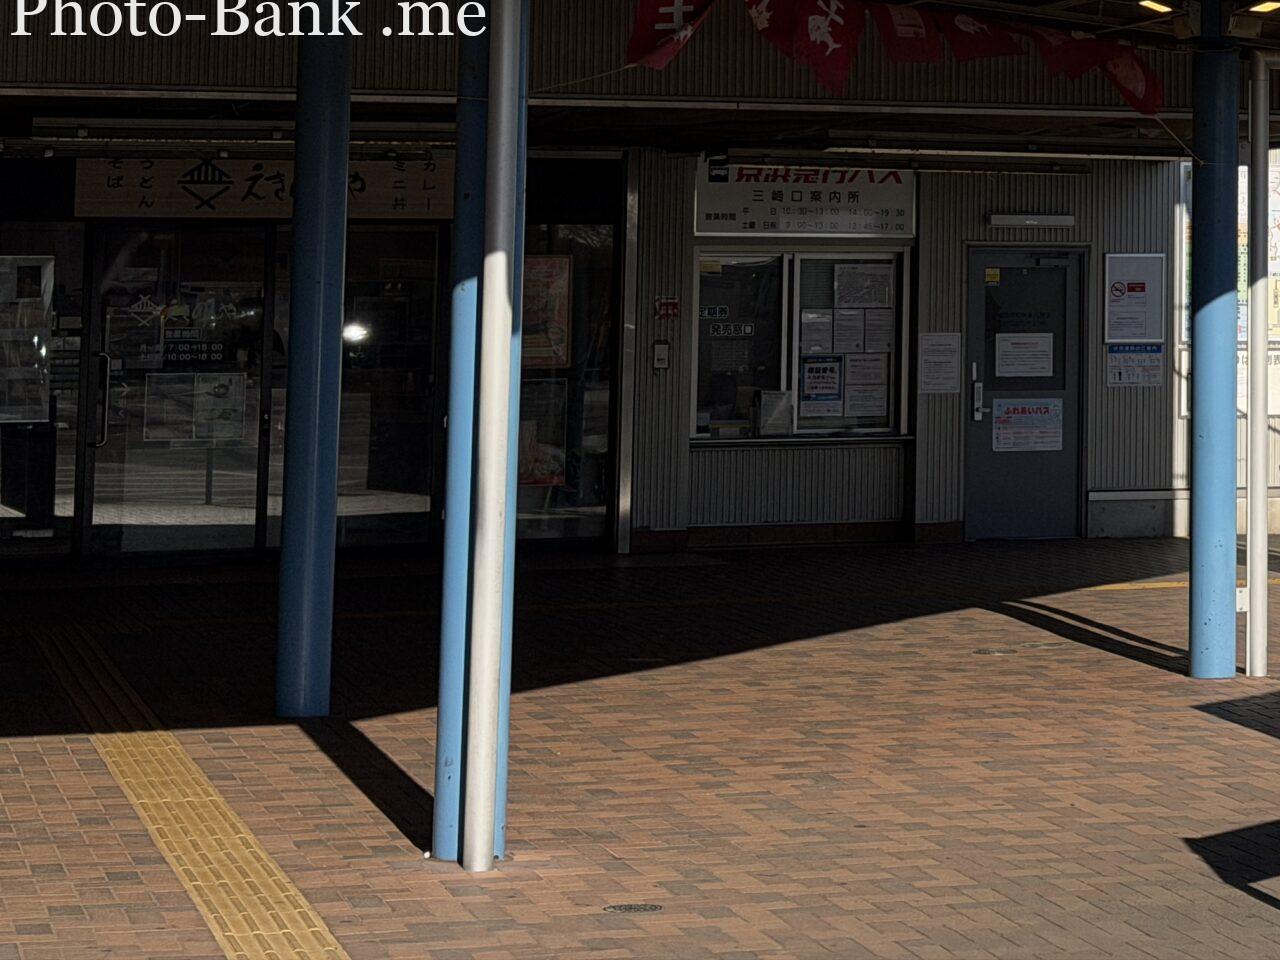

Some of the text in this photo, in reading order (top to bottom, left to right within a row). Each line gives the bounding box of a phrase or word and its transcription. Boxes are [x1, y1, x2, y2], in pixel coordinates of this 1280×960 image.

[752, 190, 860, 203] 三崎口案内所
